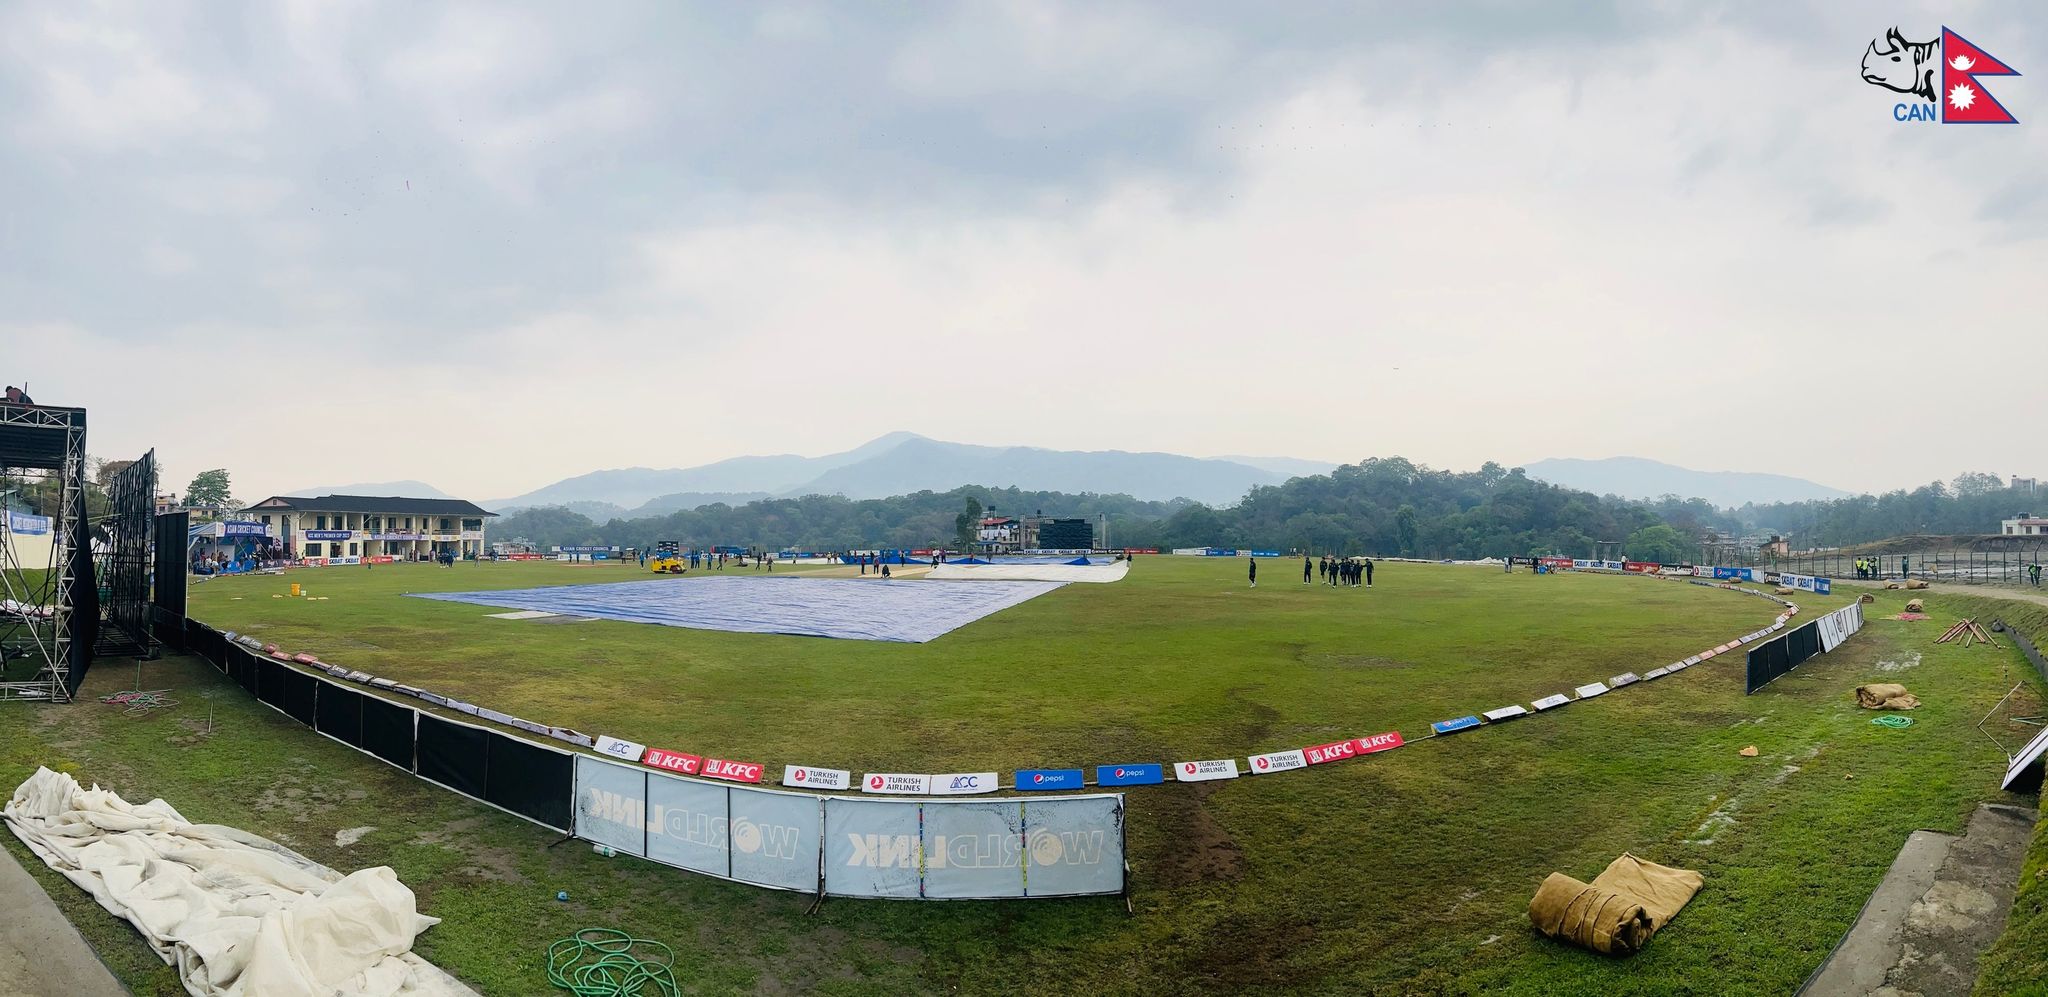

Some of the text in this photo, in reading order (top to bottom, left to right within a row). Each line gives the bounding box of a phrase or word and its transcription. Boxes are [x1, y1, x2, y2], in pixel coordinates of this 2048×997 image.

[226, 524, 237, 534] ASIAN
[237, 524, 251, 534] CRICKET
[251, 525, 264, 535] COUNCIL
[1371, 733, 1396, 746] KFC
[608, 741, 630, 755] ACC
[1322, 742, 1354, 760] KFC
[1269, 754, 1298, 763] TURKISH
[662, 755, 696, 772] KFC
[1272, 759, 1301, 769] AIRLINES
[721, 762, 758, 779] KFC
[809, 770, 838, 779] TURKISH
[1125, 769, 1145, 778] pepsi
[1199, 766, 1228, 774] AIRLINES
[807, 777, 838, 786] AIRLINES
[887, 776, 921, 785] TURKISH
[950, 776, 978, 788] ACC
[1044, 774, 1065, 783] pepsi
[886, 783, 921, 792] AIRLINES
